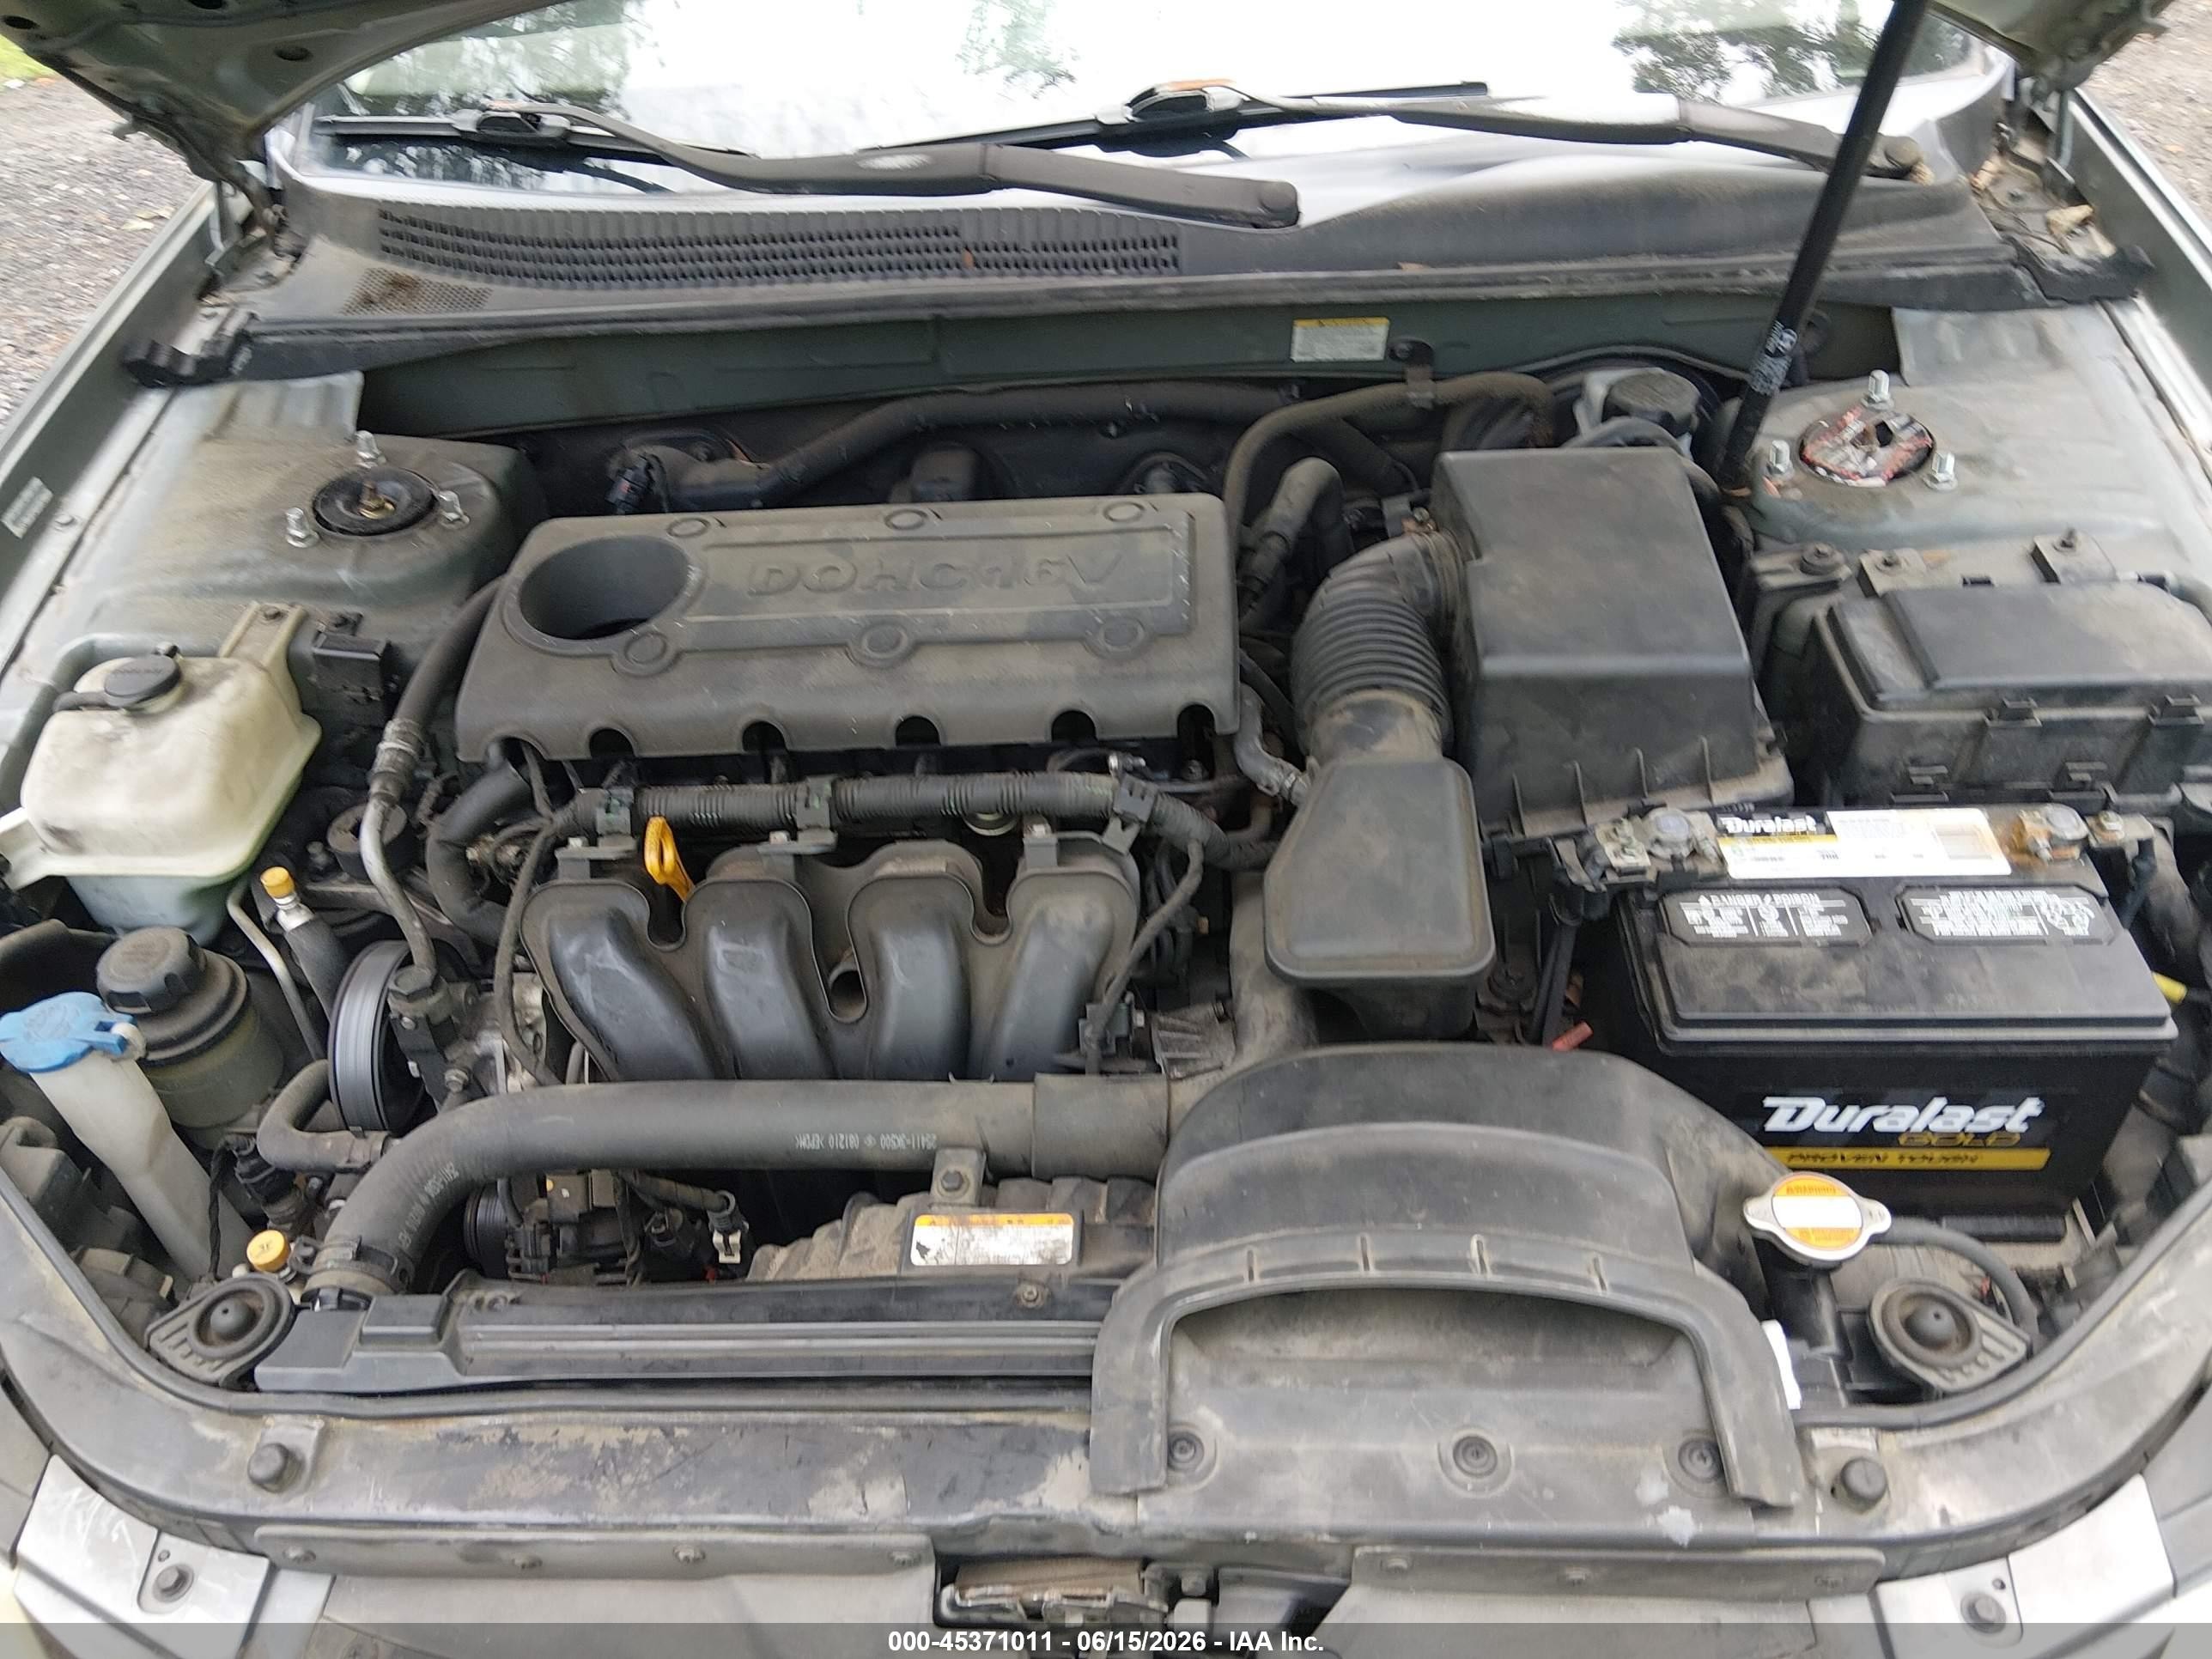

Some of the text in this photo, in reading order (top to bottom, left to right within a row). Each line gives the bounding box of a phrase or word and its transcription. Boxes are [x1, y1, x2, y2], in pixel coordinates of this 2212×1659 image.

[1720, 815, 1817, 834] Duralast
[1711, 893, 1821, 907] DANGER POISON
[1763, 1097, 2045, 1133] Duralast
[1898, 1131, 2021, 1147] GOLD
[1786, 1152, 1979, 1164] PROVEN TOUGH
